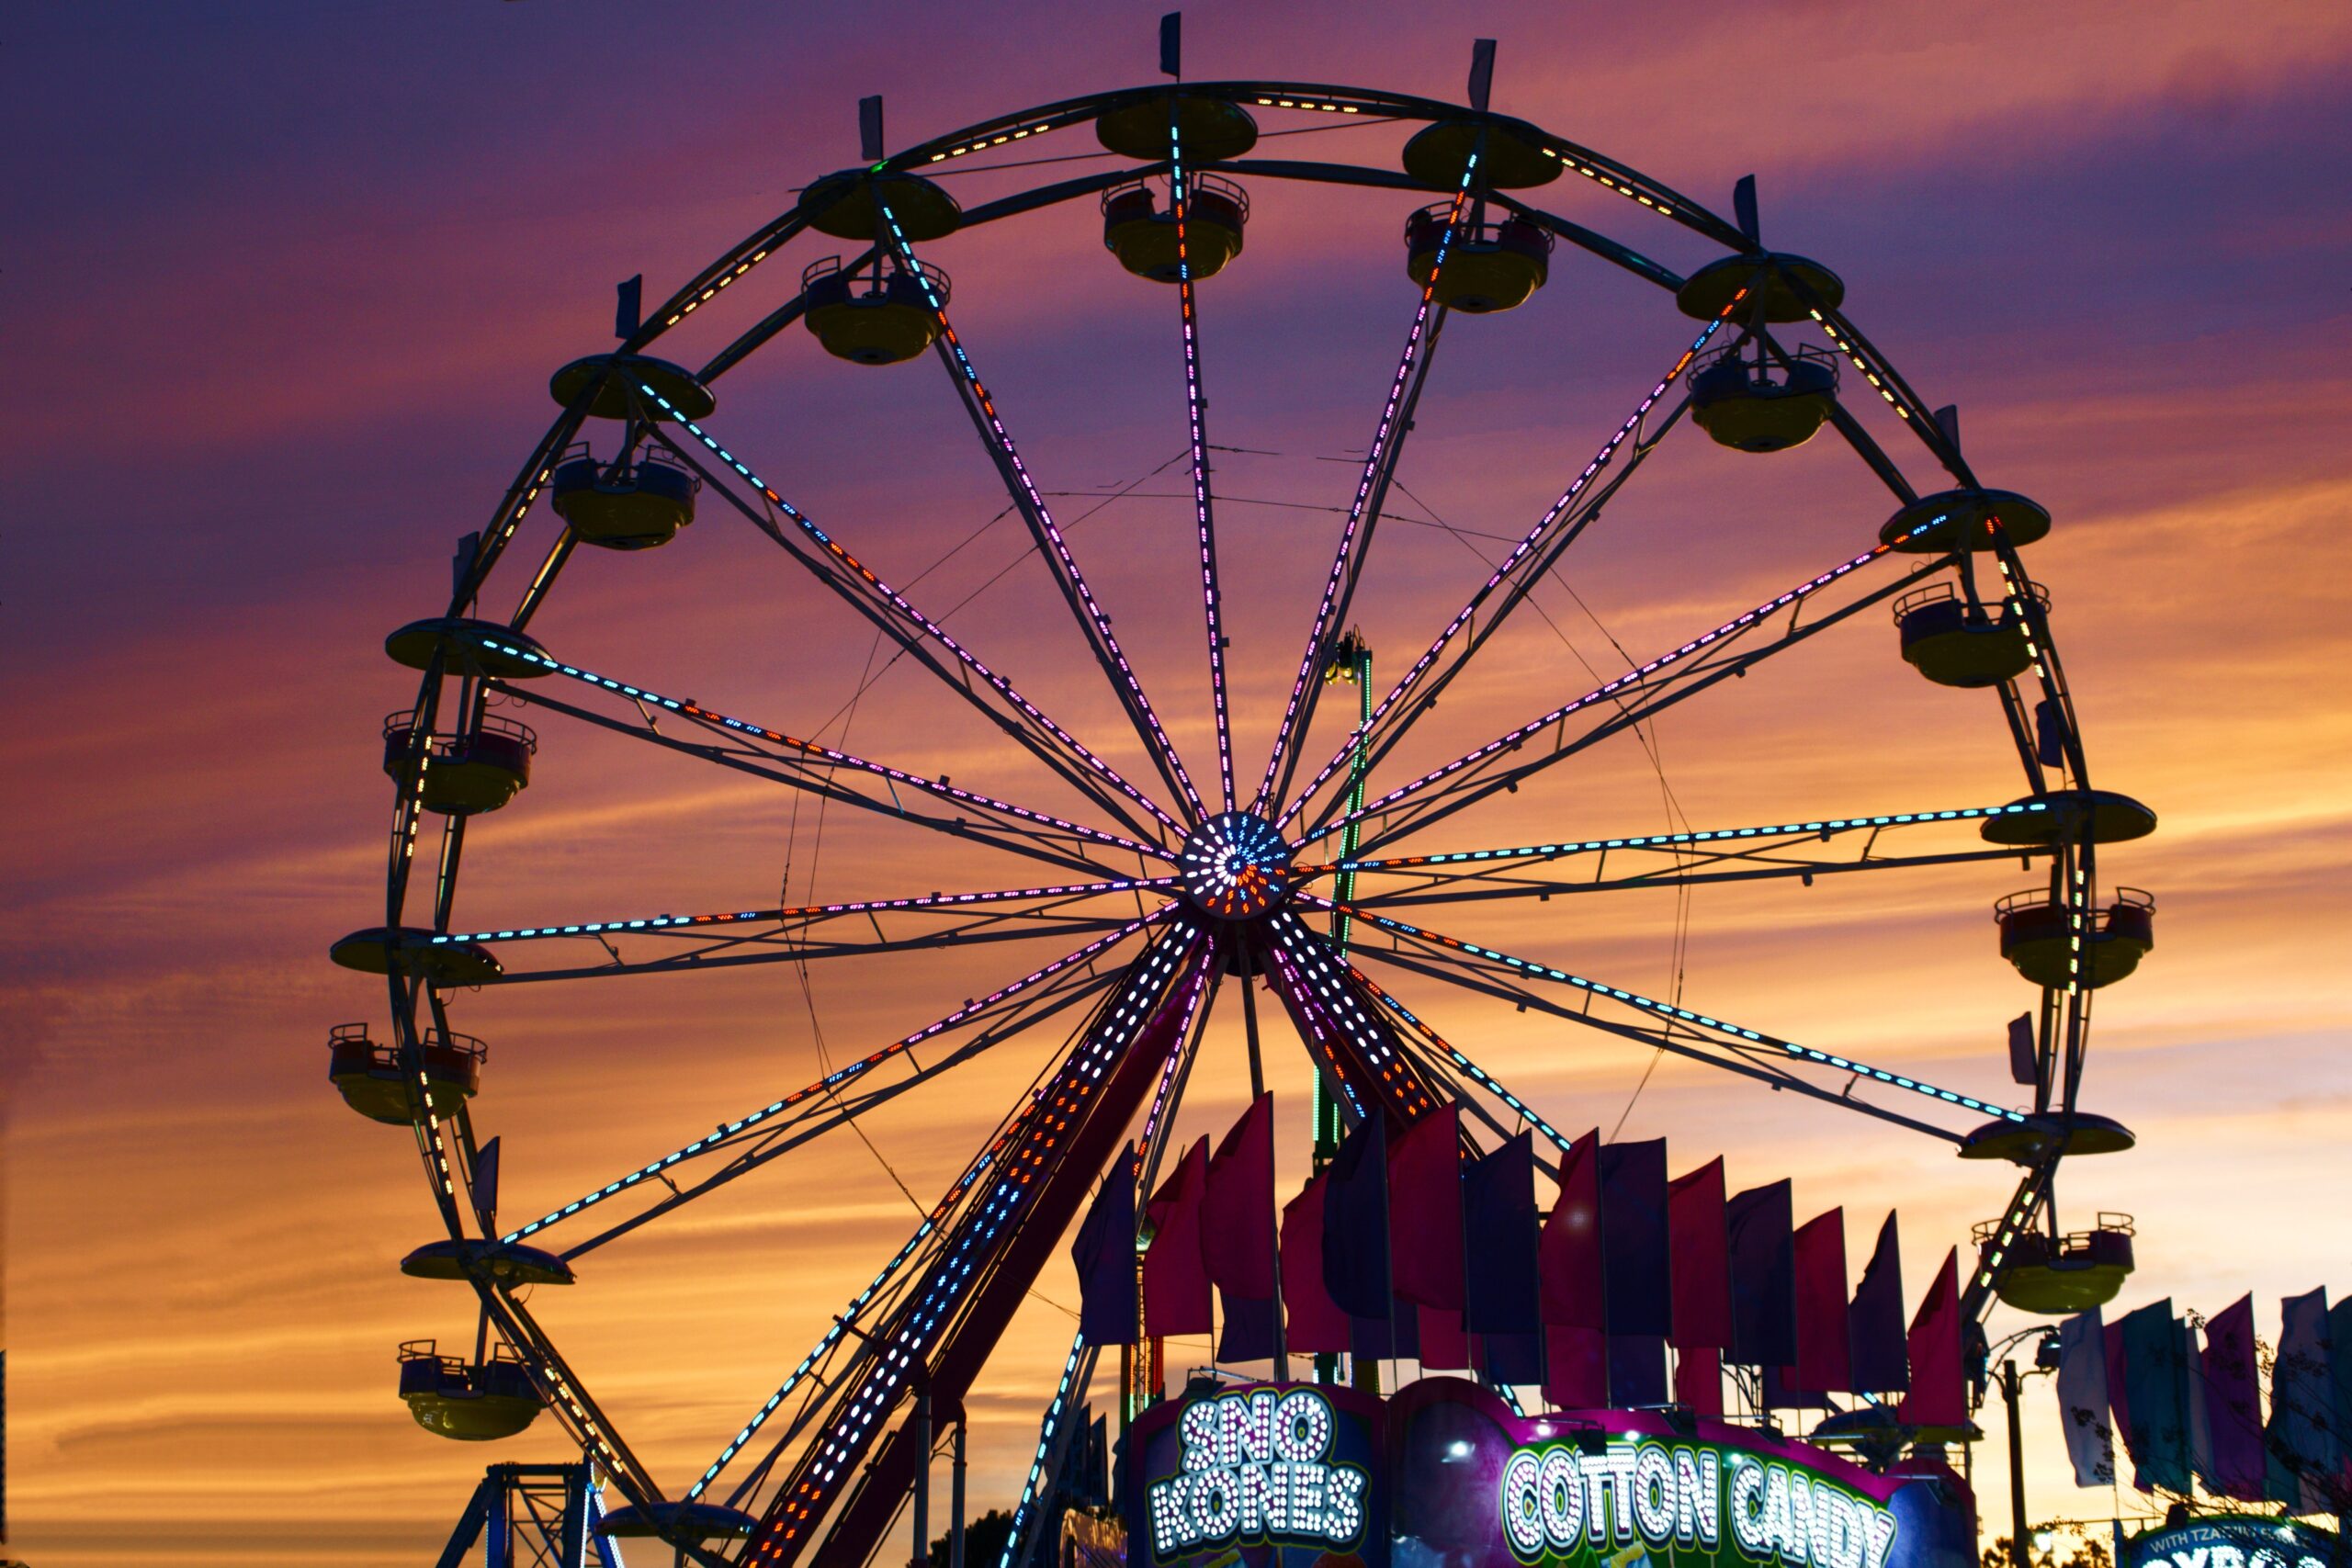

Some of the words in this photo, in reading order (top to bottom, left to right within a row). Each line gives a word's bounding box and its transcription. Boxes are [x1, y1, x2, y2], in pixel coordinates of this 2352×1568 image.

[1182, 1392, 1331, 1472] SNO
[1148, 1462, 1367, 1553] KONES
[1502, 1446, 1718, 1555] COTTON
[1731, 1459, 1895, 1567] CANDY
[2150, 1529, 2189, 1552] WITH
